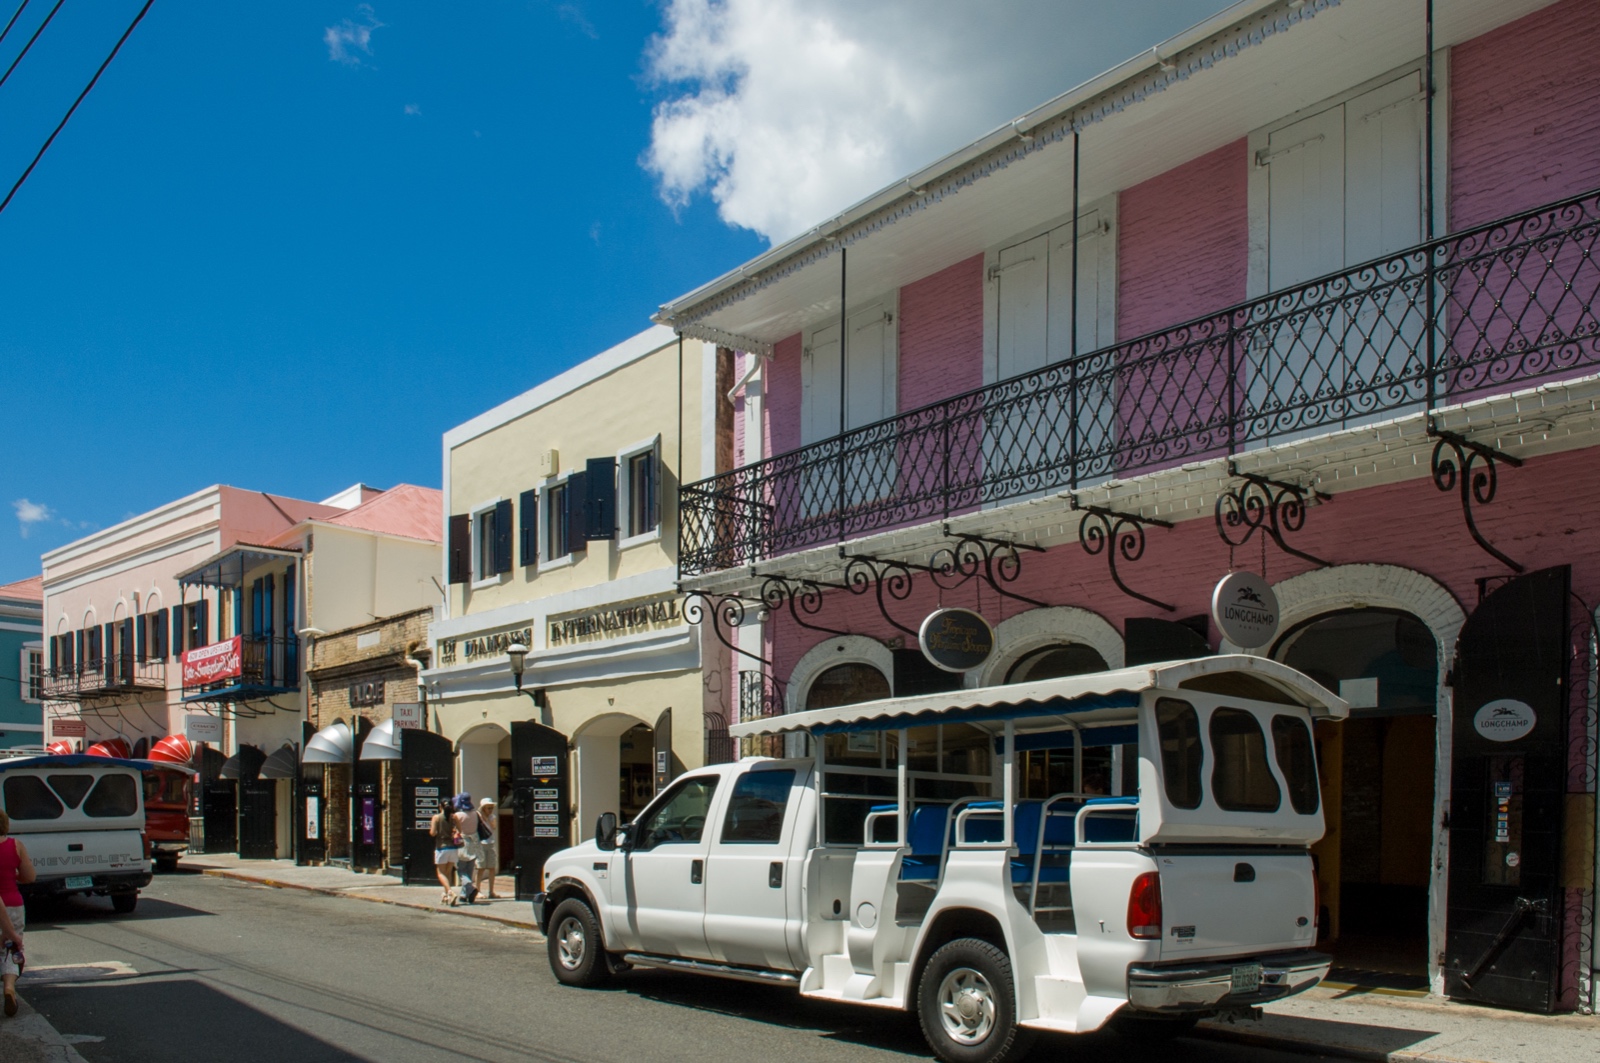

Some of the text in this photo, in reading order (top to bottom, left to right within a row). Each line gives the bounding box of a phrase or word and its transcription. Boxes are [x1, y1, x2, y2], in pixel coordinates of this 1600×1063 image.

[1225, 606, 1274, 626] LONGCHAMP
[464, 599, 680, 657] DIAMONDS INTERNATIONAL
[400, 708, 413, 717] TAXI
[394, 719, 418, 729] PARKING
[1481, 719, 1529, 728] LONGCHAMP
[32, 854, 131, 867] HEVROLET
